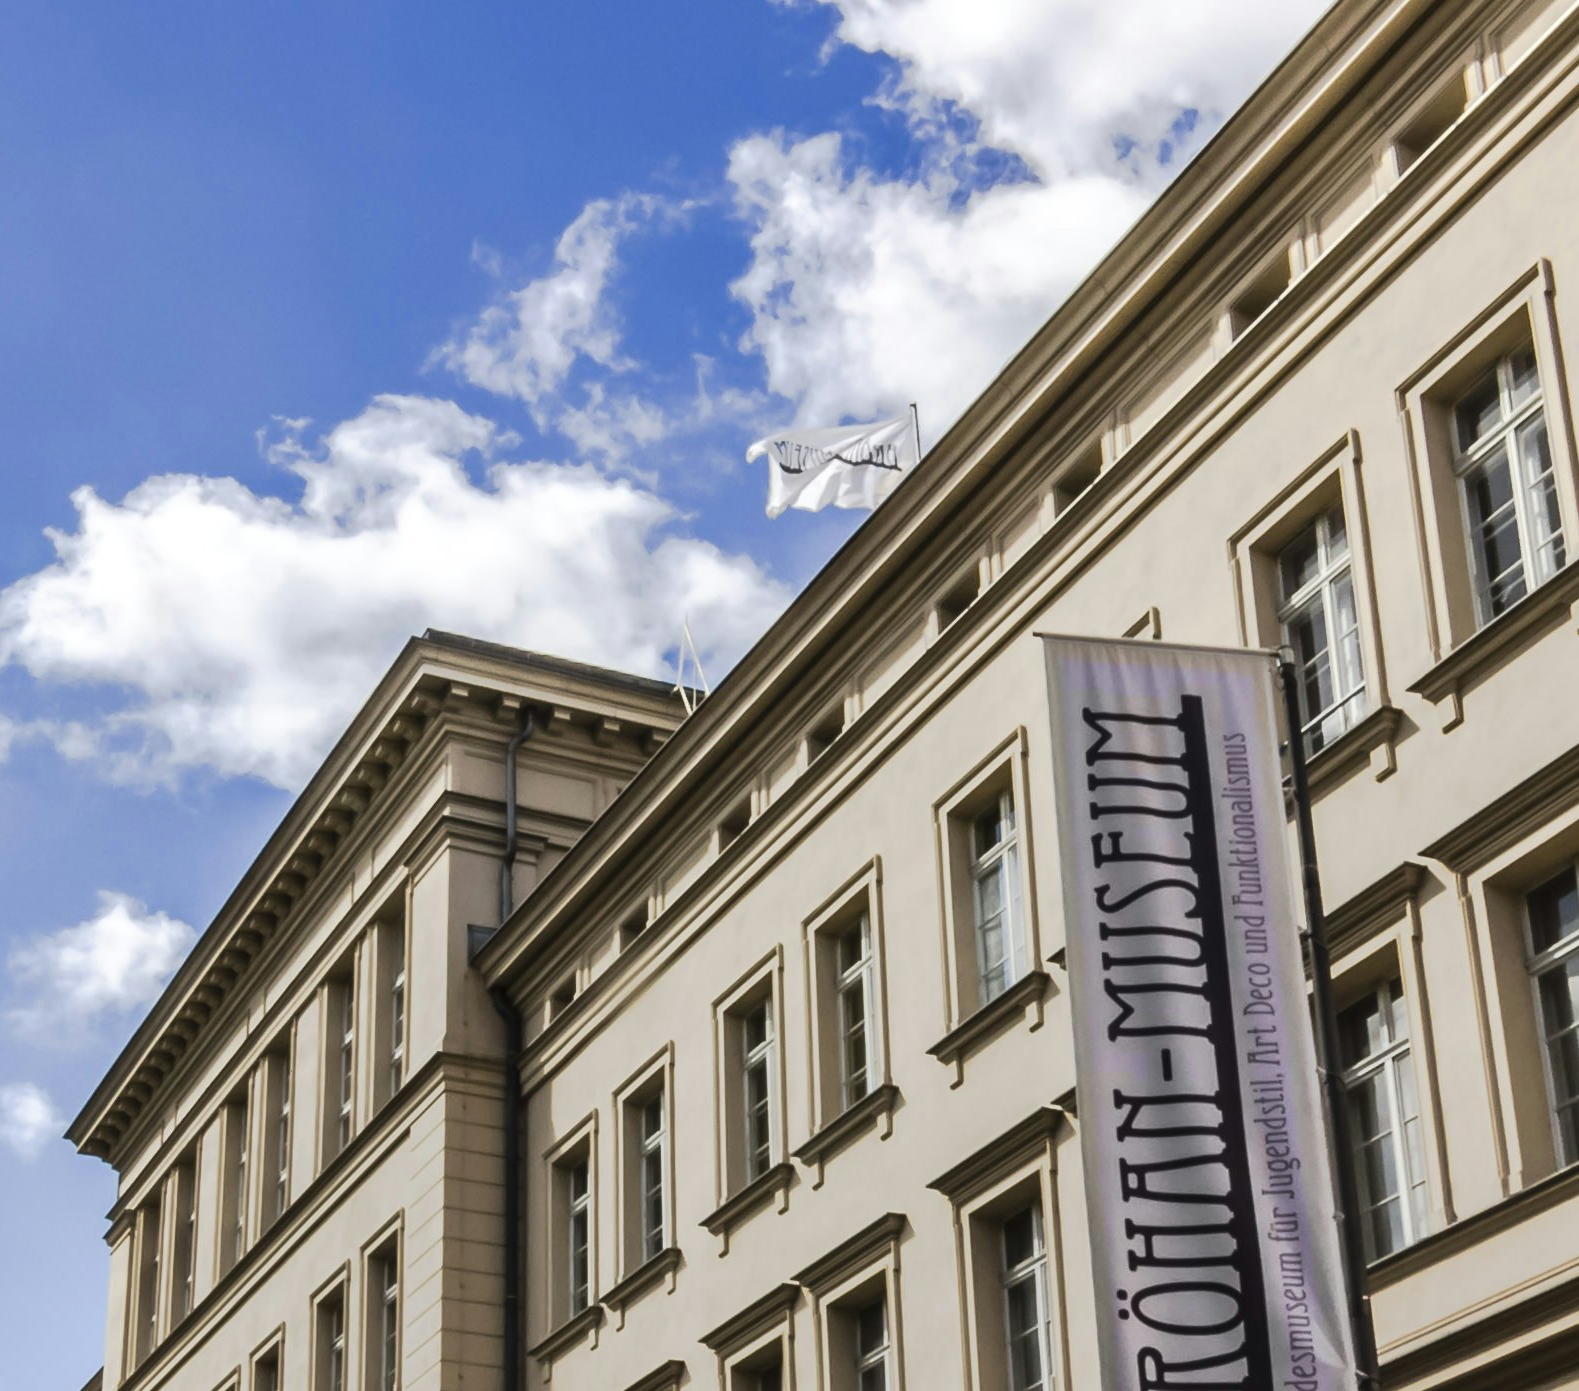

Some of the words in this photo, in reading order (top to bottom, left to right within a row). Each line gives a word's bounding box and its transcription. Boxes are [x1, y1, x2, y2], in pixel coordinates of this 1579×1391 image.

[1222, 731, 1263, 907] Funktionalismus
[1239, 914, 1268, 955] und
[1244, 959, 1275, 1016] Deco
[1248, 1027, 1280, 1067] Art
[1250, 1072, 1300, 1200] Jugendstil,
[1268, 1207, 1299, 1243] für
